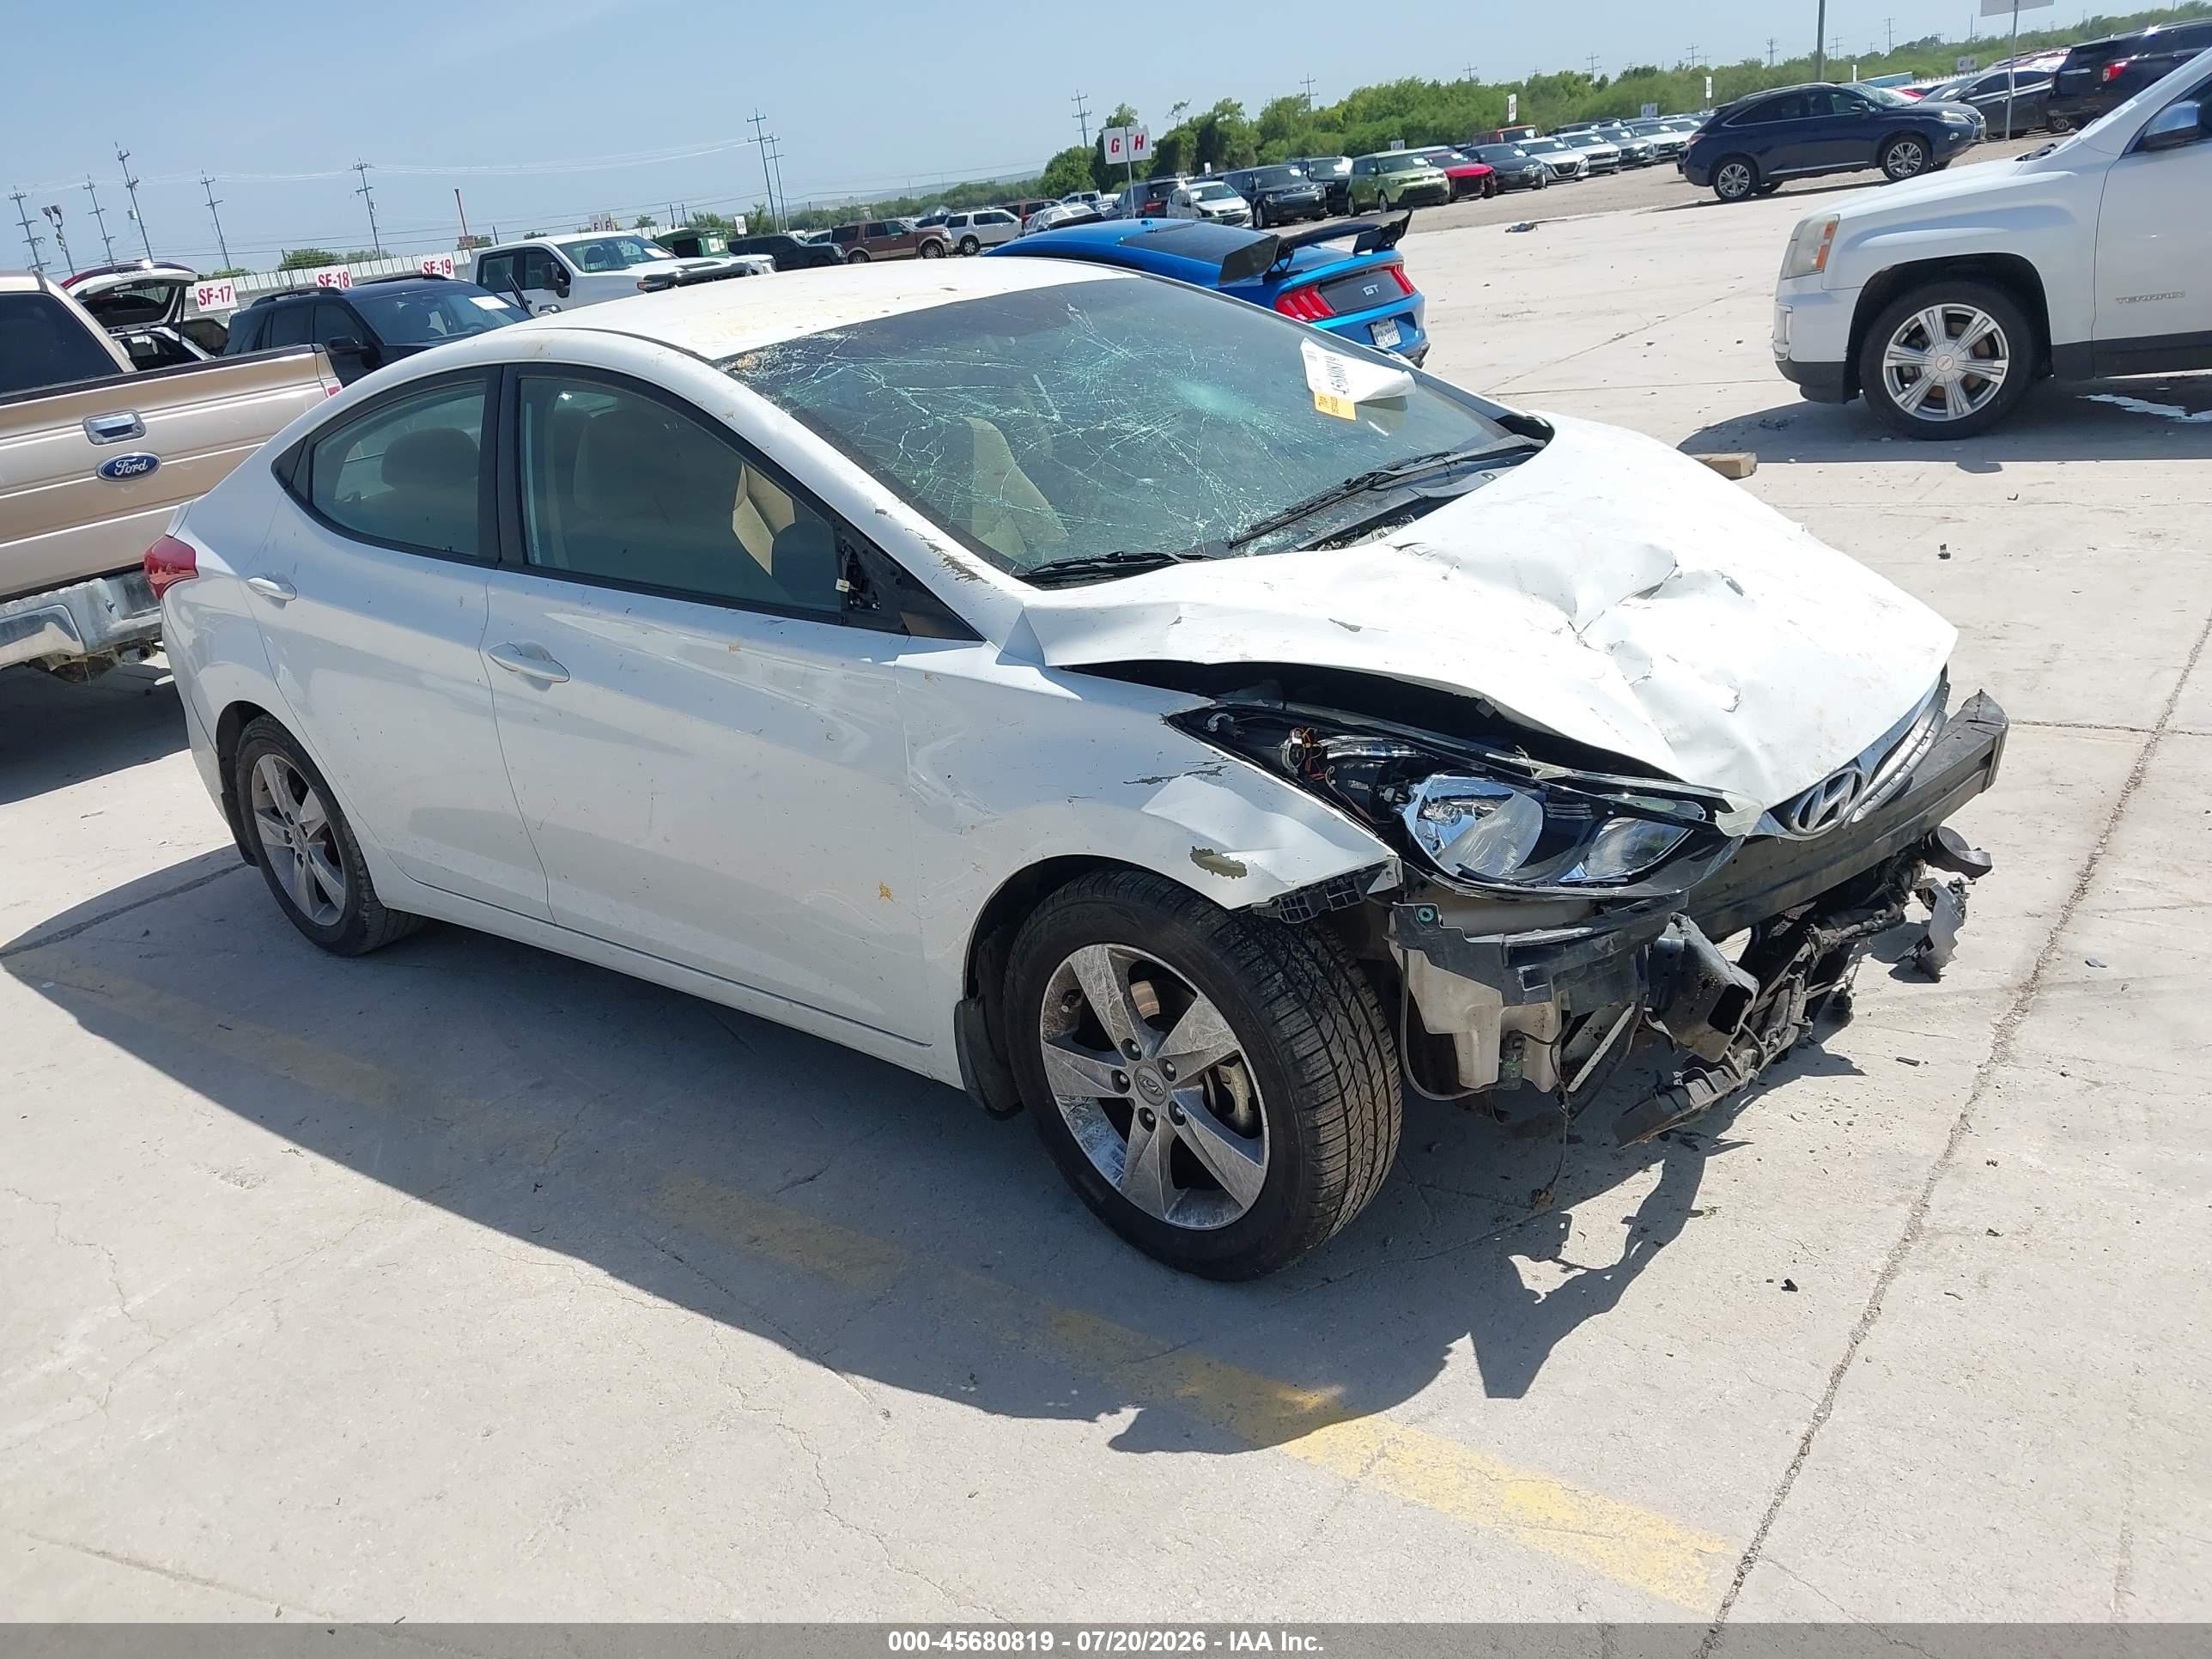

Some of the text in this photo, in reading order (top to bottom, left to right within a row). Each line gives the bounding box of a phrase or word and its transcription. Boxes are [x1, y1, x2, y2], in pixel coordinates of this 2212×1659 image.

[1111, 134, 1145, 153] G H
[423, 259, 452, 275] SF-19
[318, 271, 349, 288] SF-18
[198, 286, 231, 306] SF-17
[1363, 284, 1379, 295] GT
[2116, 290, 2185, 304] TERRAIN
[114, 458, 149, 476] Ford
